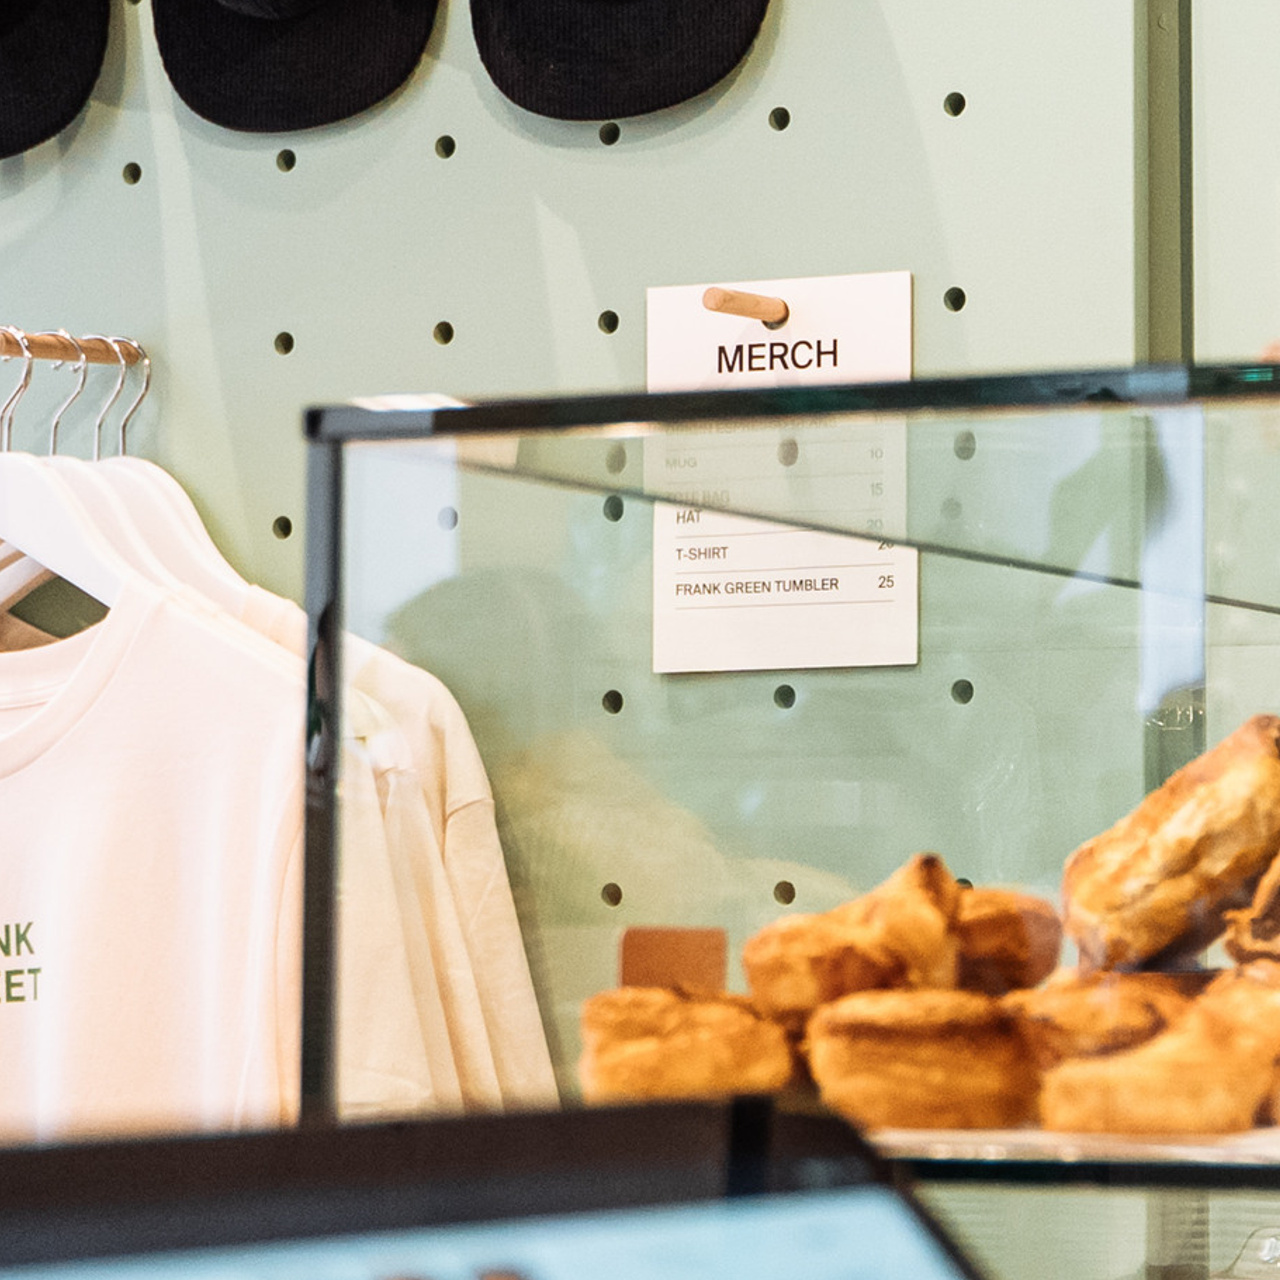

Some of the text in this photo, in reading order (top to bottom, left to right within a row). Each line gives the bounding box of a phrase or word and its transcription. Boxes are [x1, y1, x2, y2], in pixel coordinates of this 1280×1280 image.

[717, 338, 838, 373] MERCH
[665, 447, 884, 469] MUG 10
[870, 482, 884, 496] 15
[676, 508, 702, 524] HAT
[675, 546, 729, 561] T-SHIRT
[675, 575, 895, 596] FRANK GREEN TUMBLER 25
[0, 966, 41, 1003] ET
